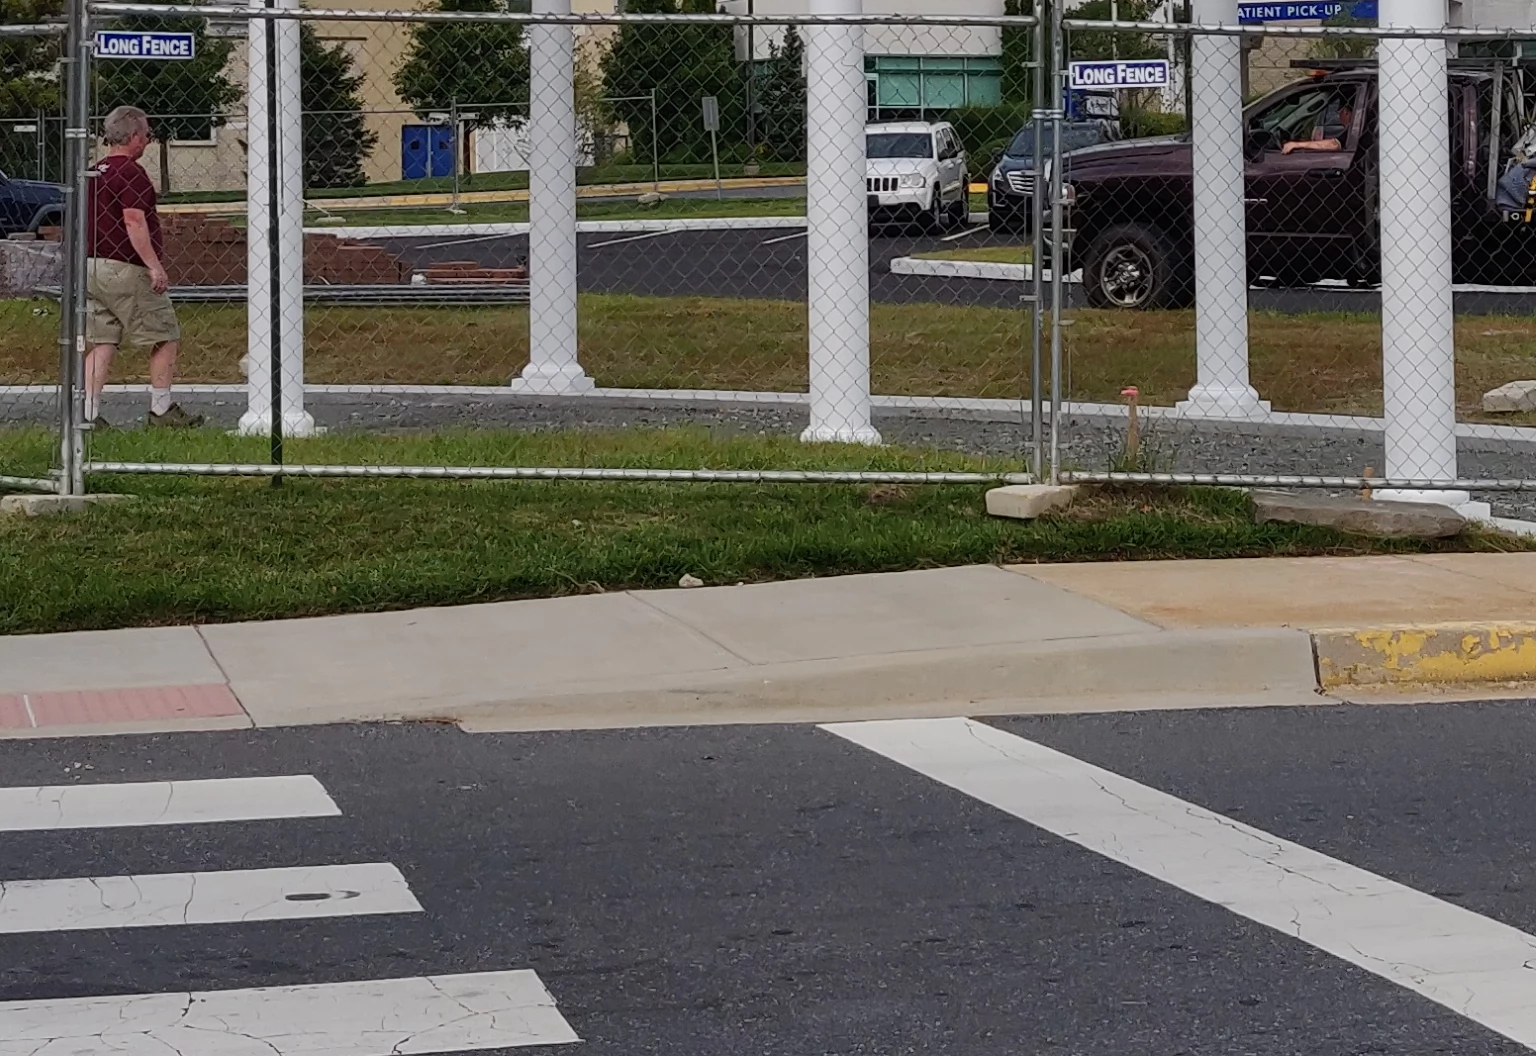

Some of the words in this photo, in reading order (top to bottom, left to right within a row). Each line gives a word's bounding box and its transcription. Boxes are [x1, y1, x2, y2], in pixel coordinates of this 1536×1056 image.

[1238, 6, 1281, 19] ATIENT
[1287, 4, 1342, 17] PICK-UP
[100, 35, 139, 54] LONG
[142, 36, 190, 55] FENCE
[1075, 65, 1115, 84] LONG
[1116, 64, 1164, 83] FENCE
